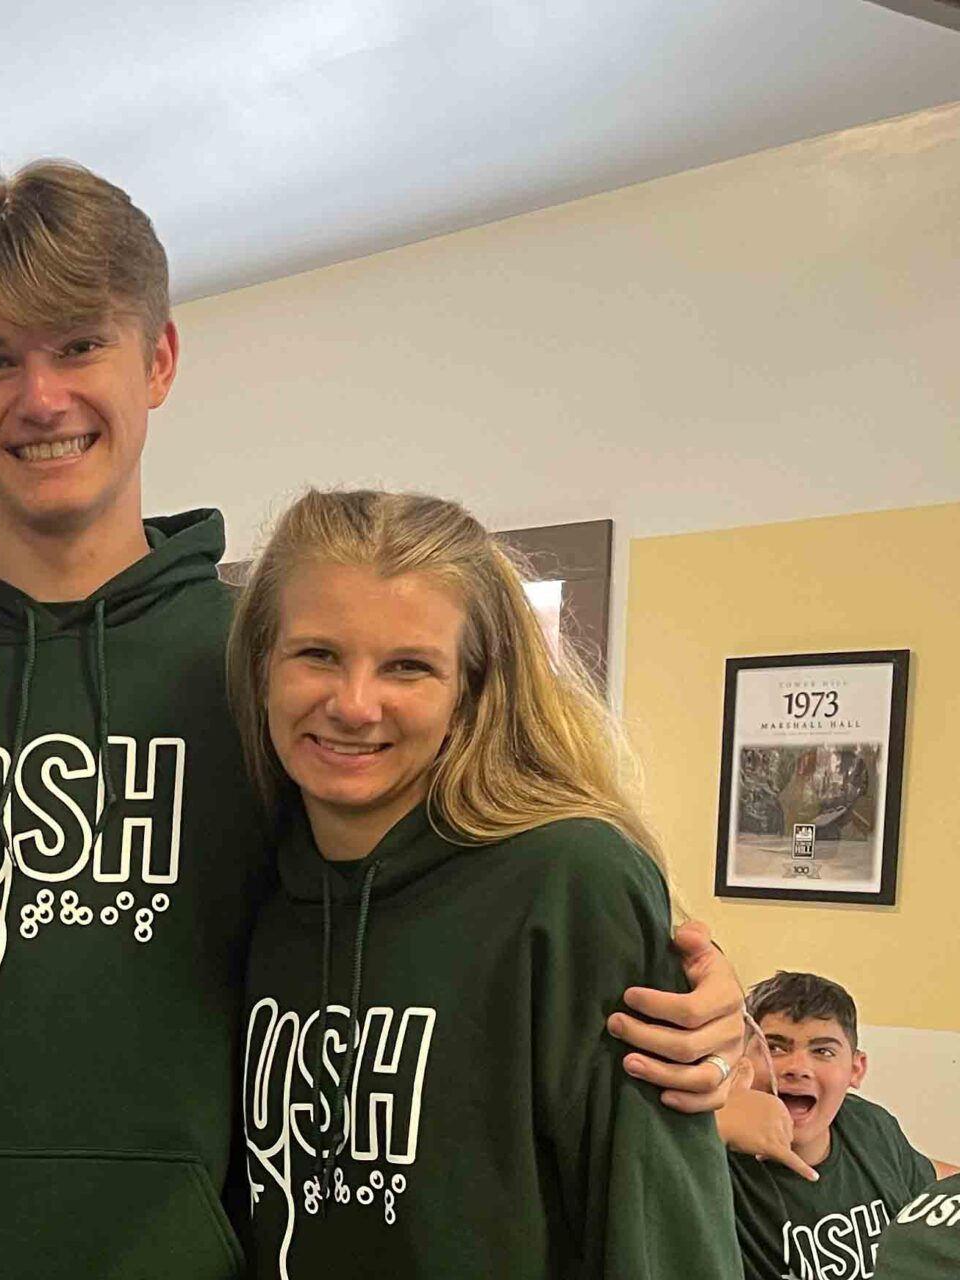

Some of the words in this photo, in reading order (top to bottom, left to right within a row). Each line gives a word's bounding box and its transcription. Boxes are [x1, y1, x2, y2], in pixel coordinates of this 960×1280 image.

[783, 690, 839, 718] 1973
[760, 721, 823, 730] MARSHALL
[829, 719, 861, 729] HALL
[243, 998, 437, 1164] USH
